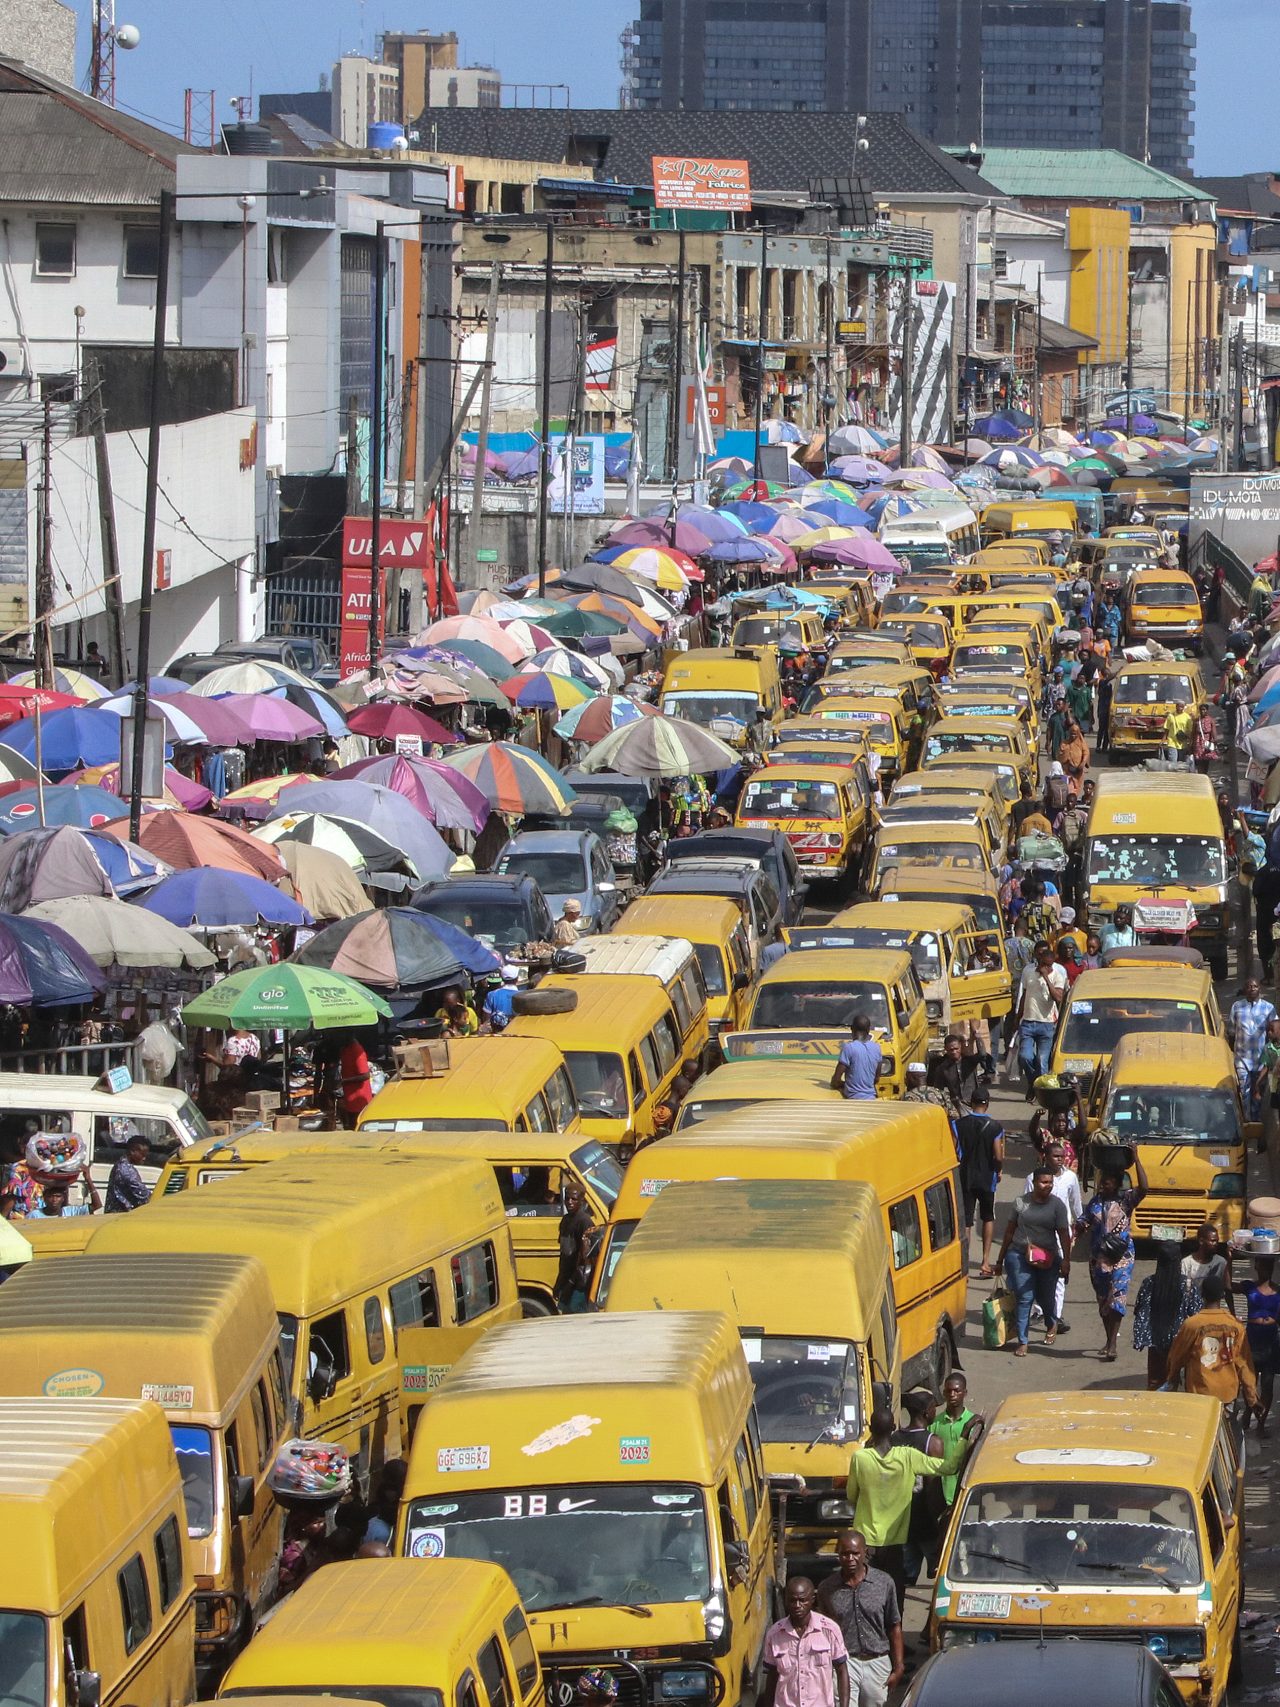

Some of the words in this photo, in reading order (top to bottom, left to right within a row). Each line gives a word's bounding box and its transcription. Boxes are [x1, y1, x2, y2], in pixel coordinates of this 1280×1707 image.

[707, 181, 746, 189] Fabrics
[707, 407, 719, 418] CO
[1243, 477, 1280, 491] IDUMOTA
[1203, 490, 1262, 504] IDUMOTA
[487, 564, 525, 576] MUSTER
[262, 988, 285, 999] glo
[52, 1373, 90, 1384] CHOSEN
[403, 1375, 427, 1388] 2023
[428, 1374, 446, 1388] 20
[620, 1446, 650, 1461] 2023
